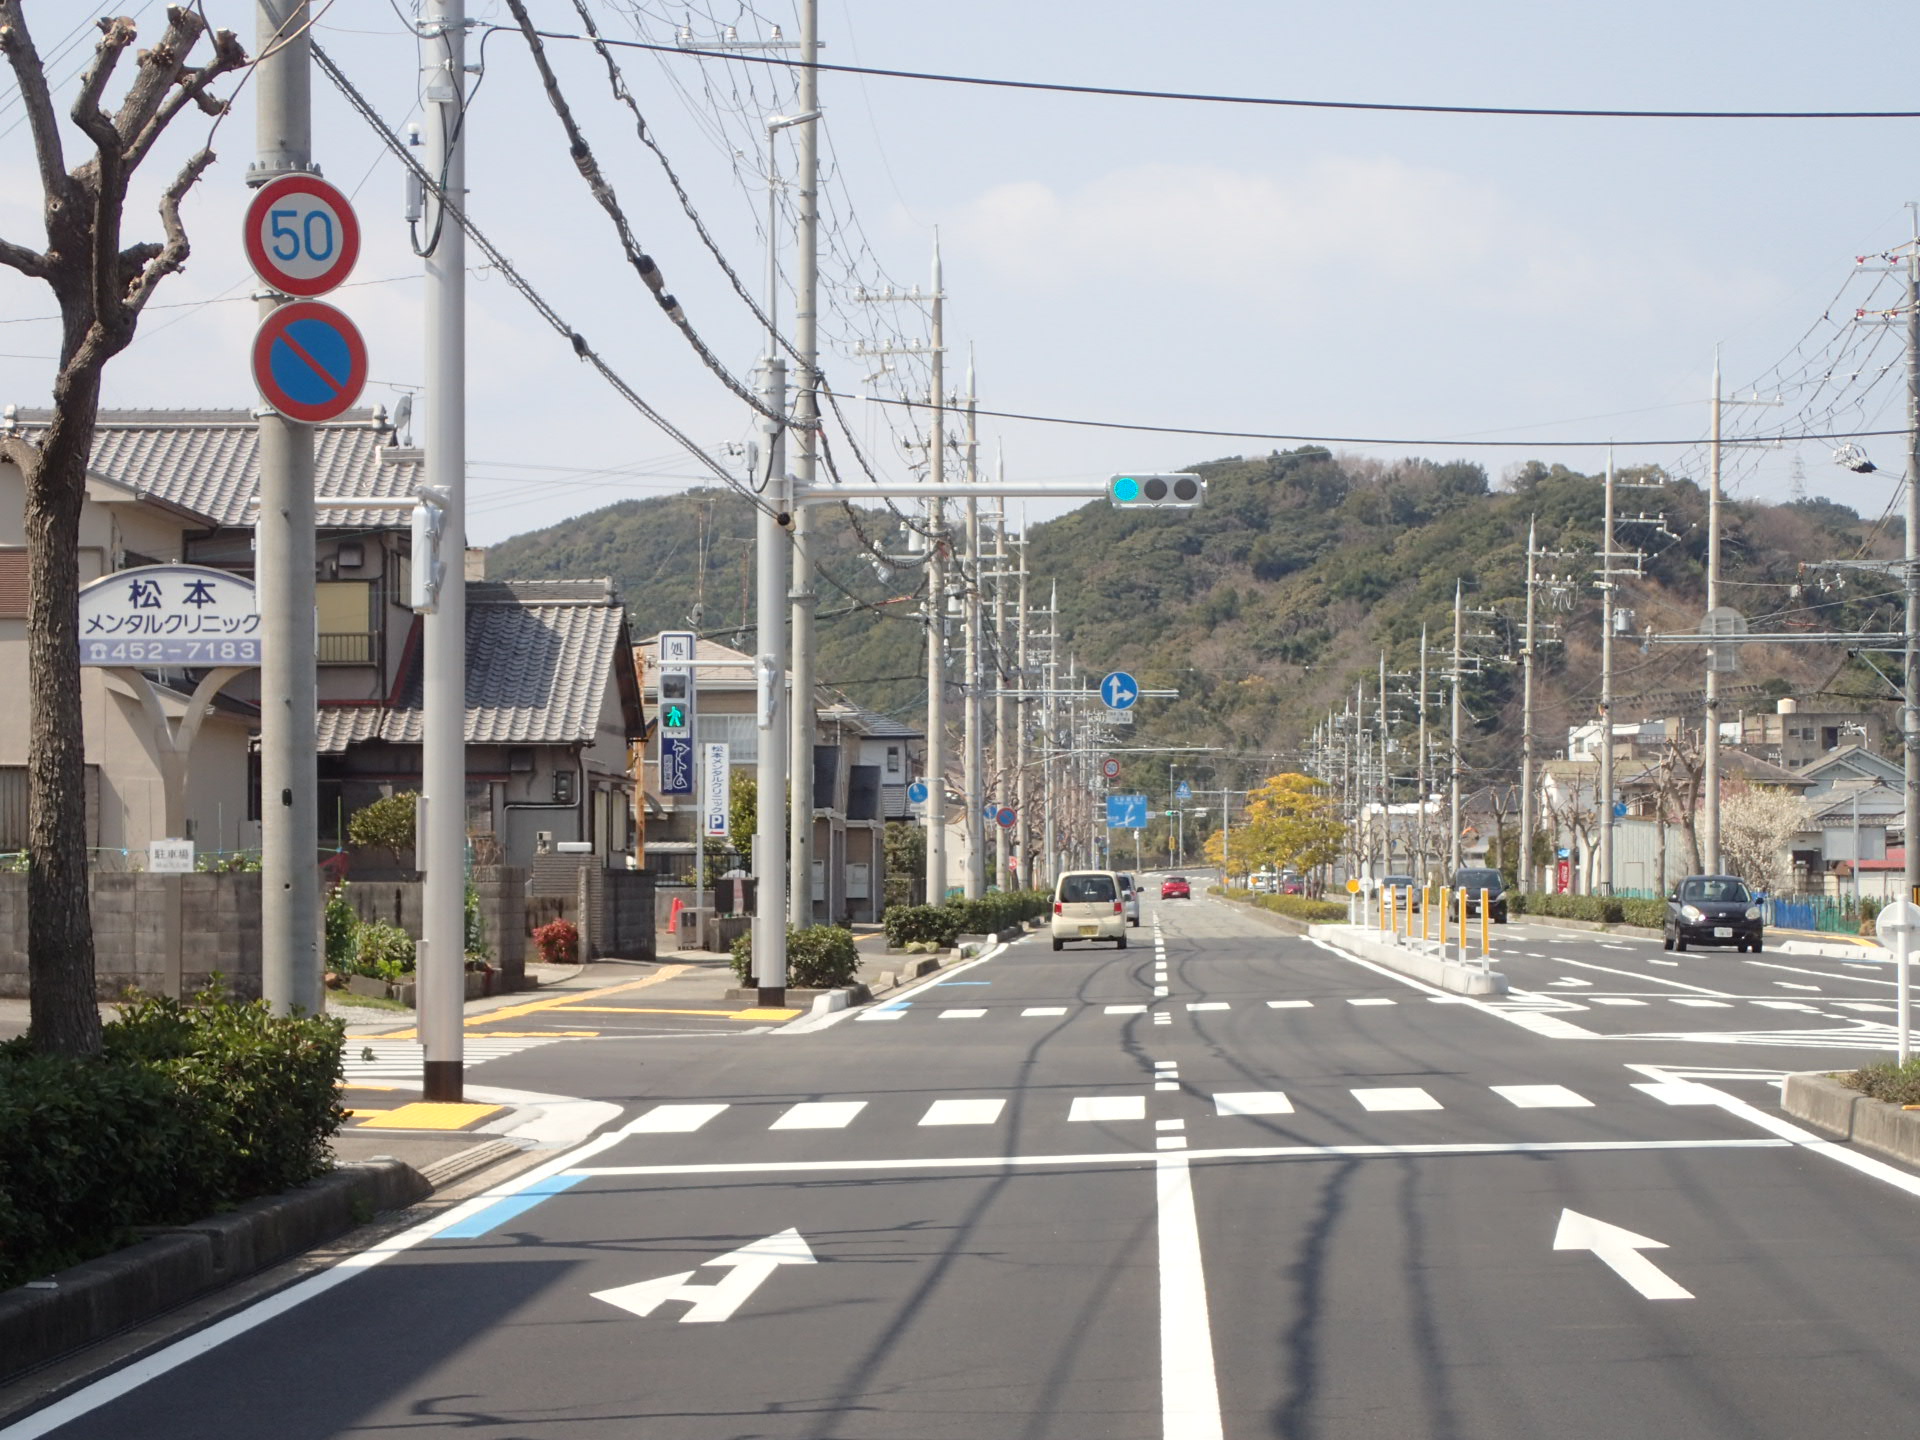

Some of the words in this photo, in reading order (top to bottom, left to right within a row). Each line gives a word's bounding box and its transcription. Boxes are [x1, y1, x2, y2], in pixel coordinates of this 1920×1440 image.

[271, 210, 333, 261] 50
[128, 579, 216, 609] 松本
[85, 614, 260, 634] メンタルクリニック
[111, 643, 255, 660] 452-7183
[711, 745, 724, 813] 松本メンタルクリニック
[711, 815, 723, 829] P
